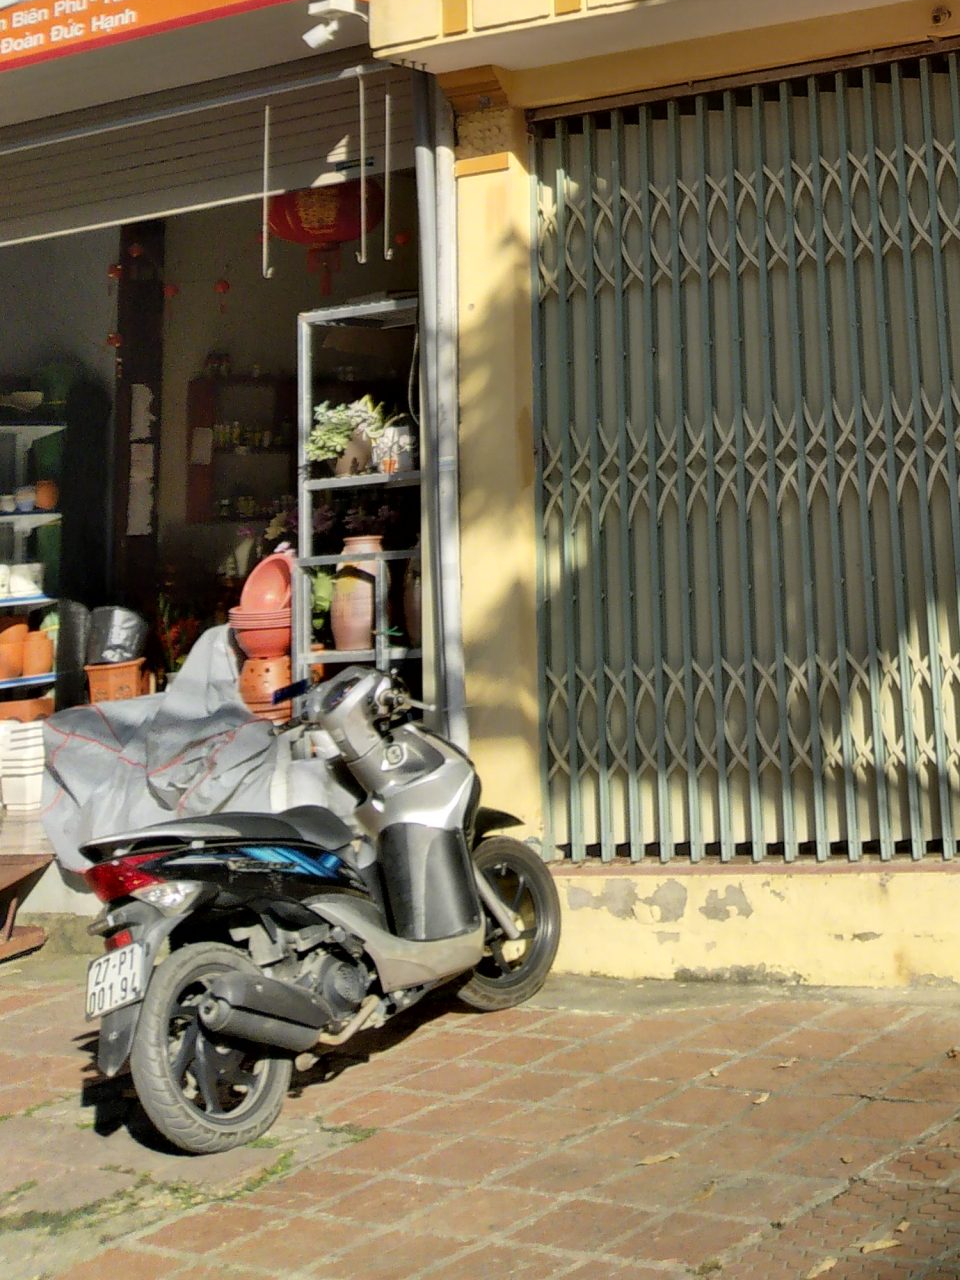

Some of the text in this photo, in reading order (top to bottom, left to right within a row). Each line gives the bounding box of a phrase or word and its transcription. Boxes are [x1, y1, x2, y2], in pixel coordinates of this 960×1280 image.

[0, 8, 137, 55] Đoàn Đức Hạnh
[12, 8, 49, 28] Biên
